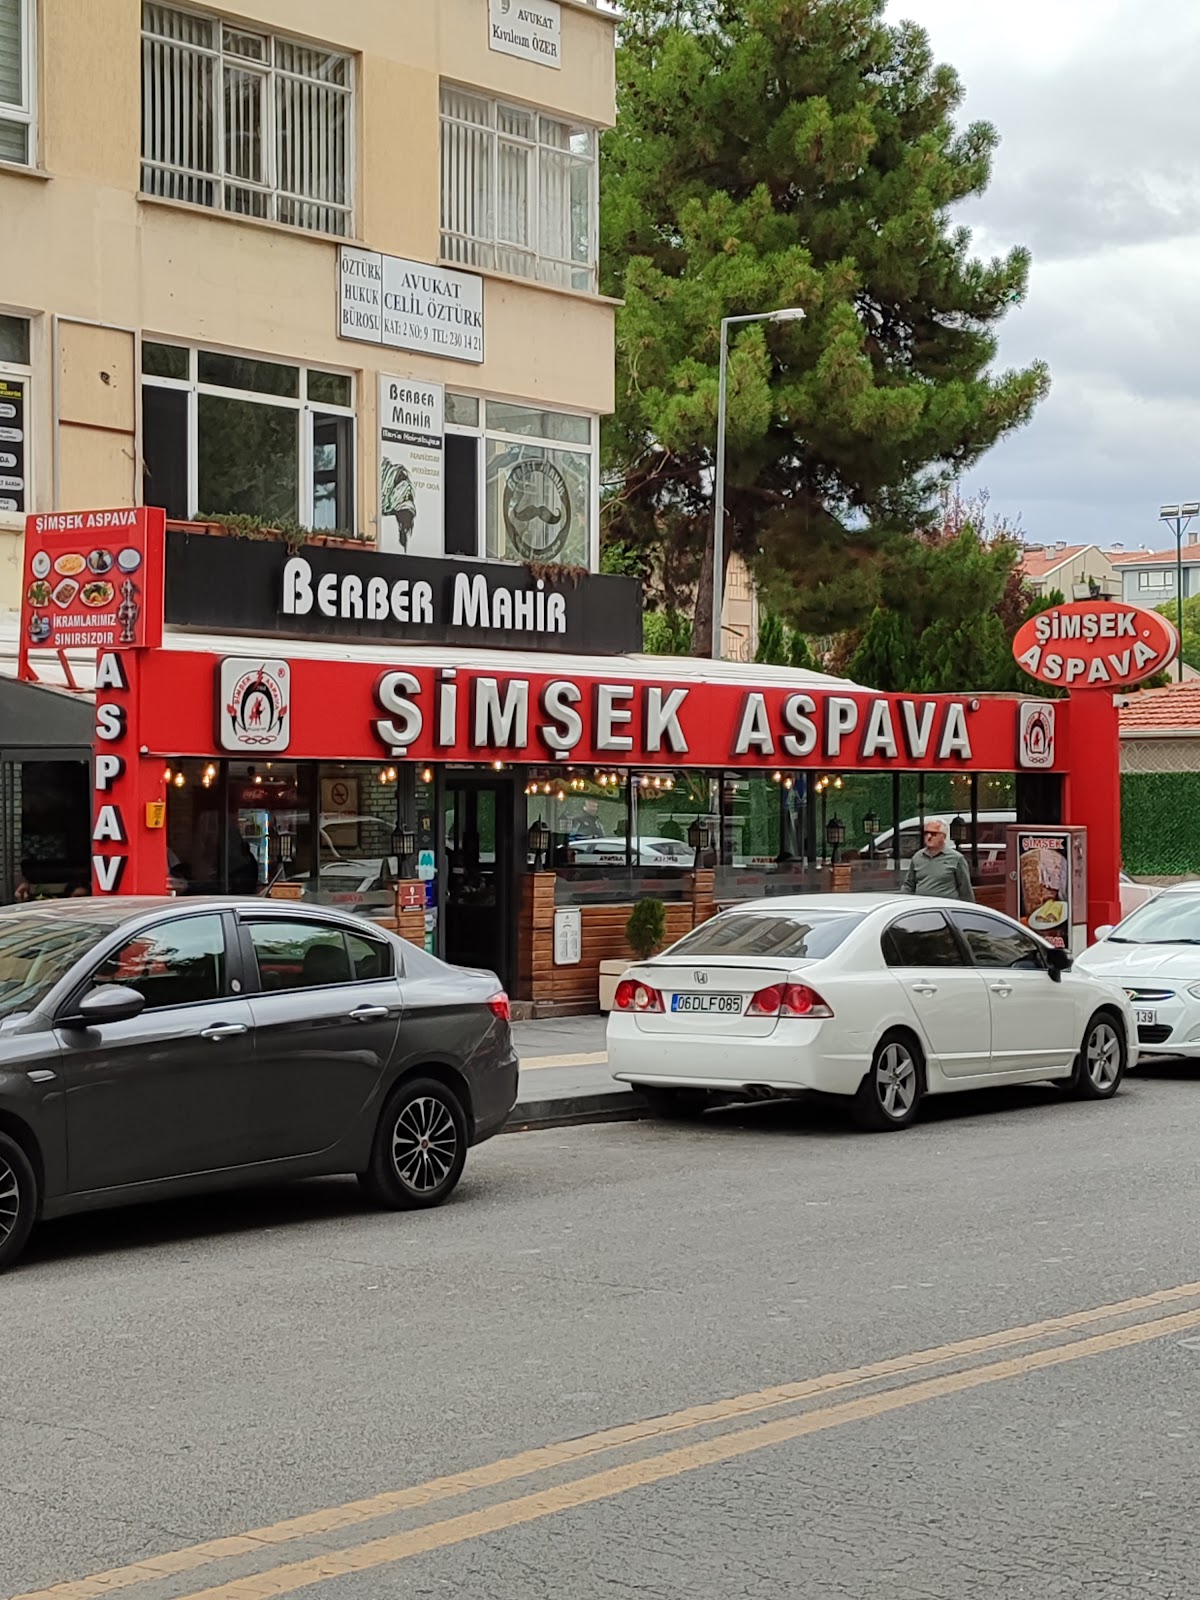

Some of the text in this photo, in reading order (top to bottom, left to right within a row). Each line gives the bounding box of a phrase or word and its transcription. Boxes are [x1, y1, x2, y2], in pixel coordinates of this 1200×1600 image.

[517, 9, 554, 30] AVUKAT
[532, 32, 558, 58] ÖZER
[342, 254, 381, 281] ÖZTÜRK
[344, 283, 379, 306] HUKUK
[401, 272, 463, 299] AVUKAT
[342, 306, 380, 331] BÜROSU
[384, 291, 482, 328] CELİL ÖZTÜRK
[384, 318, 401, 335] KAT:
[402, 322, 408, 336] 2
[424, 326, 429, 341] 9
[431, 328, 449, 345] TEL:
[449, 331, 463, 347] 230
[464, 335, 473, 349] 14
[473, 335, 482, 351] 21
[35, 511, 138, 534] ŞİMŞEK ASPAVA
[53, 613, 117, 629] İKRAMLARIMIZ
[1035, 612, 1137, 645] ŞİMŞEK
[54, 632, 114, 646] SINIRSIZDIR
[1018, 640, 1158, 684] ASPAVA
[375, 668, 973, 760] ŞİMŞEK ASPAVA
[1136, 1011, 1154, 1023] 139
